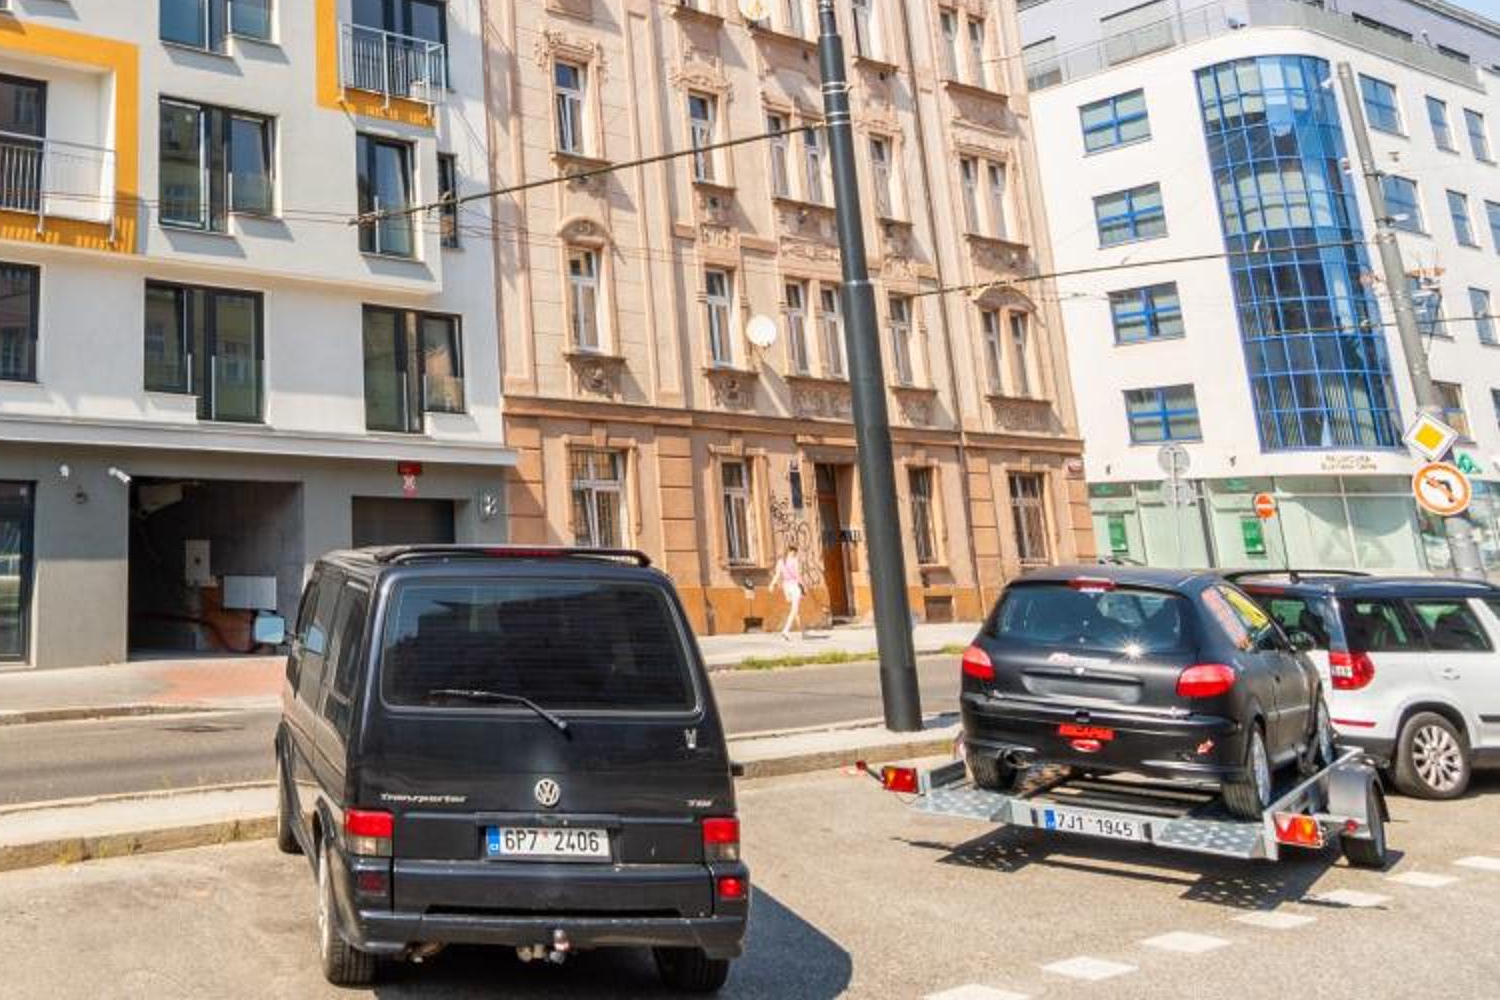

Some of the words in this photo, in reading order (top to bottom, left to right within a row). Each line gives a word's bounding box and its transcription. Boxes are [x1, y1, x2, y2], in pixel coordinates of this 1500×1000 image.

[1058, 813, 1084, 831] 7J1
[1095, 818, 1133, 837] 1945
[505, 830, 539, 851] 6P7
[555, 831, 600, 852] 2406
